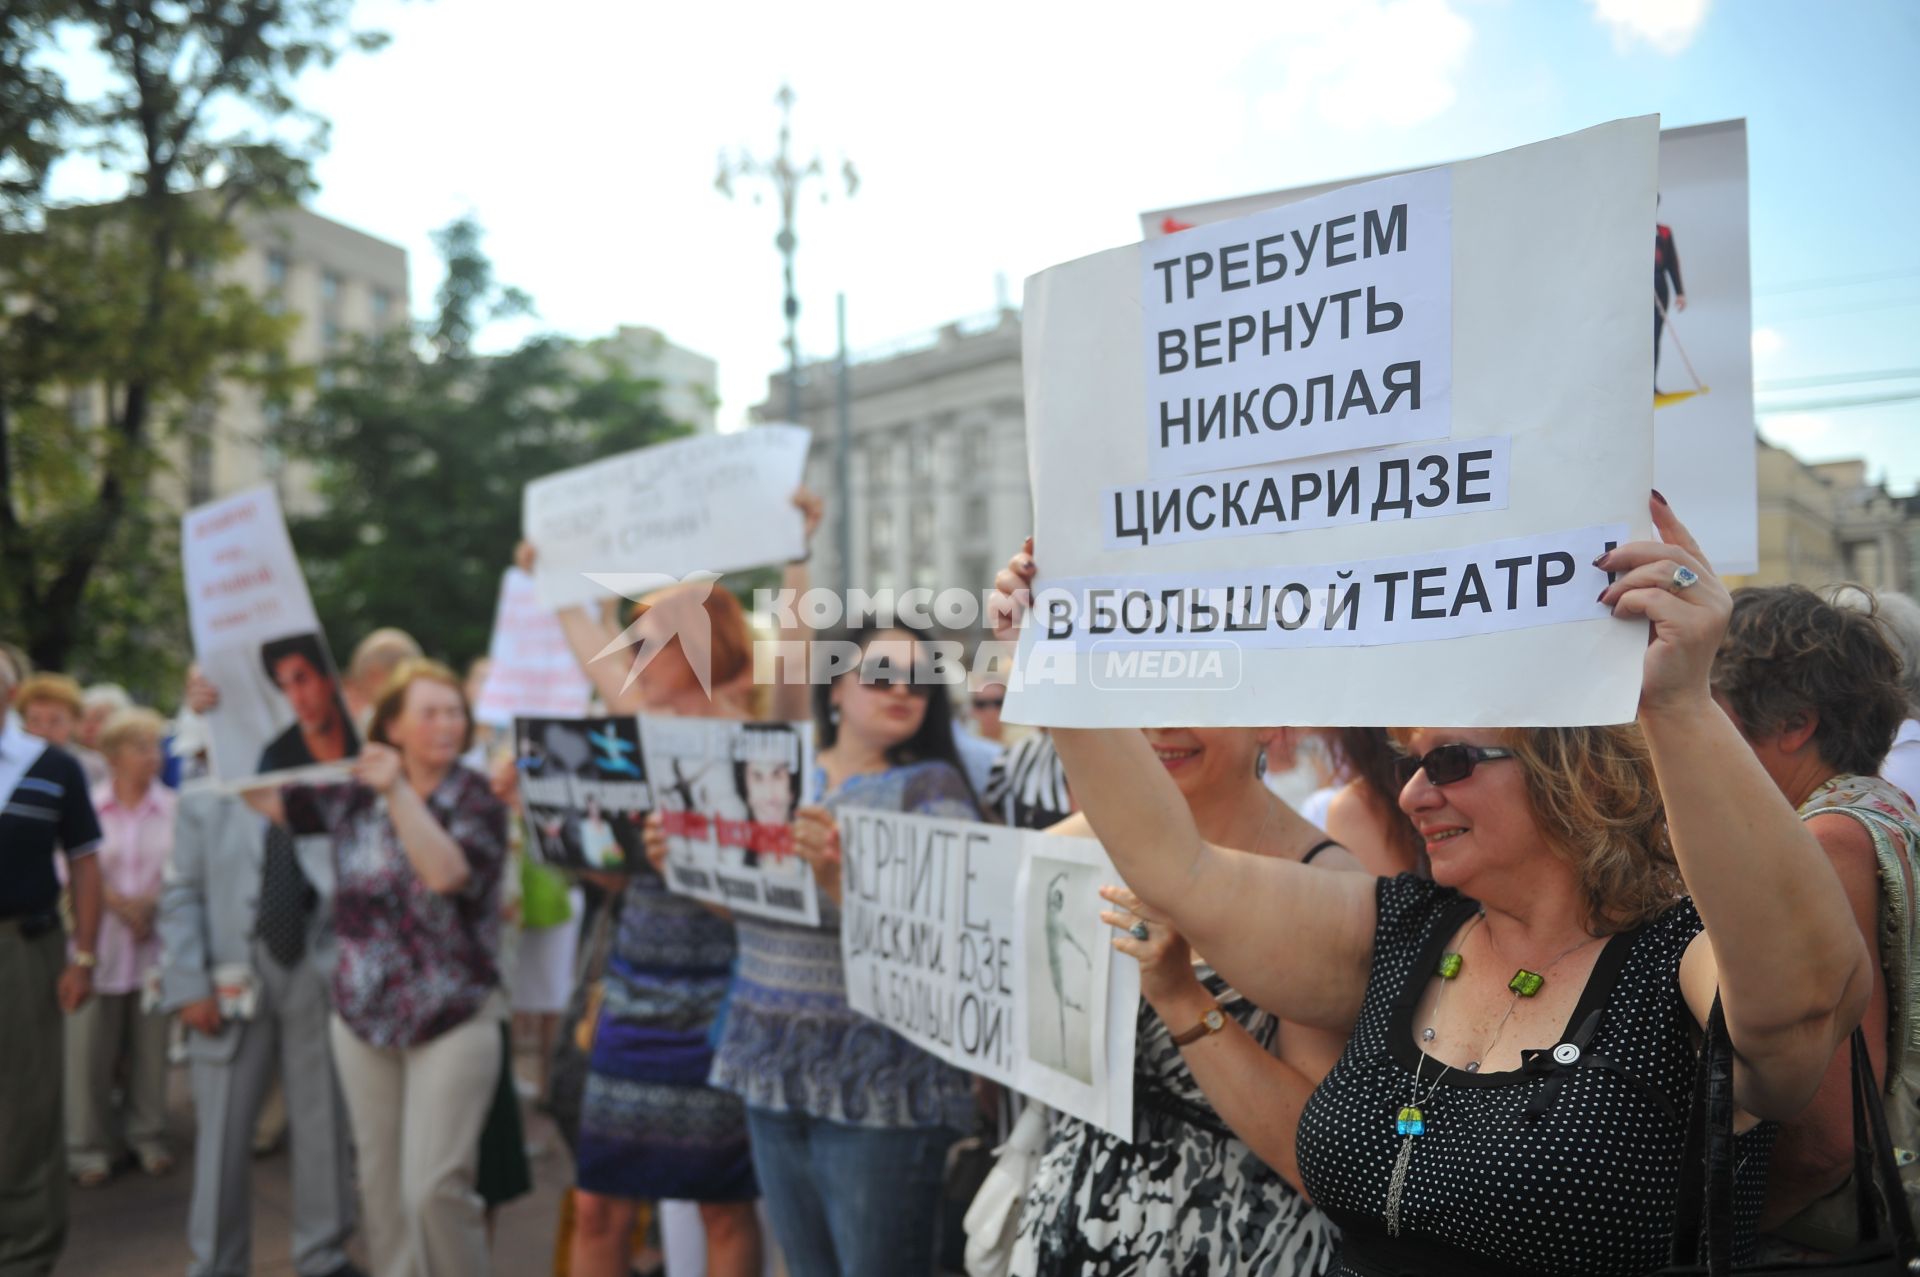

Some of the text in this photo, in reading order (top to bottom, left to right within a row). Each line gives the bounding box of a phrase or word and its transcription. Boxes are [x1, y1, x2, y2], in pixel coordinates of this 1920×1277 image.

[1153, 203, 1409, 304] ТРЕБУЕМ
[1156, 285, 1404, 376] ВЕРНУТЬ
[1159, 359, 1422, 449] НИКОЛАЯ
[1113, 449, 1494, 546] ЦИСКАРИДЗЕ
[1046, 598, 1074, 640] В
[1088, 569, 1362, 635] БОЛЬШОЙ
[1374, 550, 1576, 620] ТЕАТР
